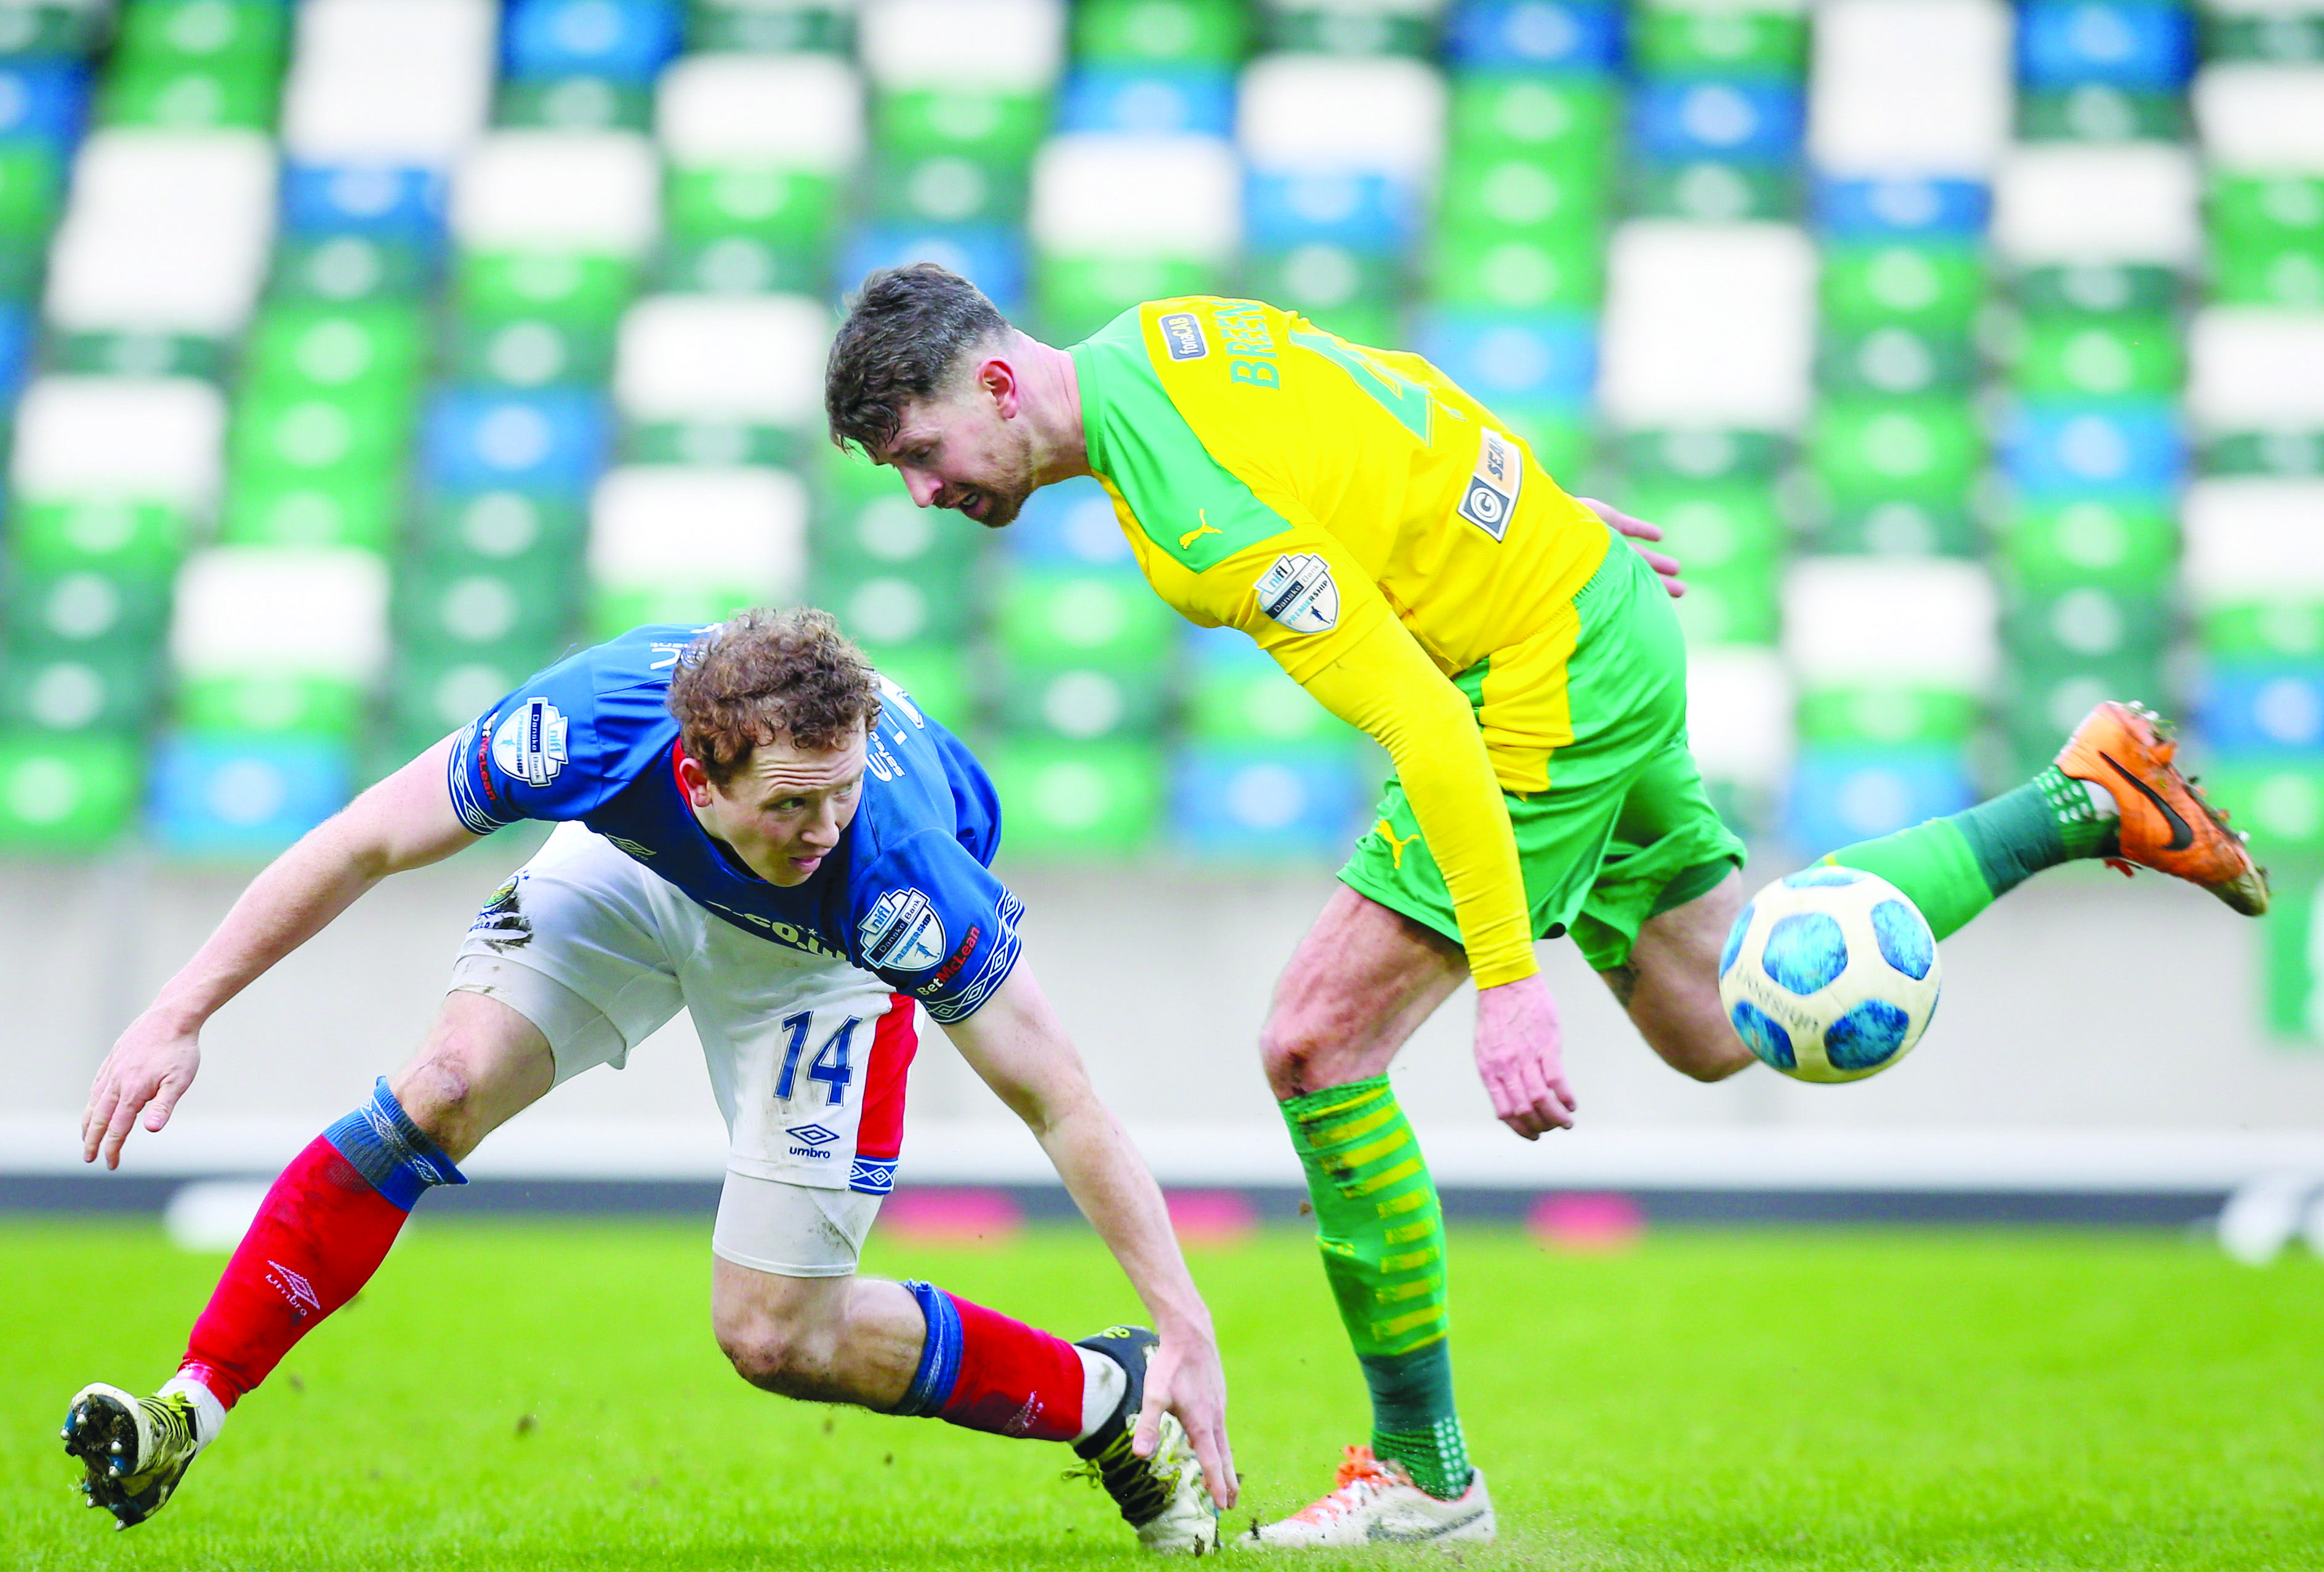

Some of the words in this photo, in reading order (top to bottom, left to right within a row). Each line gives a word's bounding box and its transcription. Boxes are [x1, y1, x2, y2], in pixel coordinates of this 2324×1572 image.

[1168, 316, 1200, 355] fonaCAB
[1211, 302, 1280, 390] BREEN
[1301, 565, 1319, 583] Bank
[1286, 579, 1328, 625] PREMIERSHIP
[532, 714, 540, 751] Danske
[533, 756, 541, 780] Bank
[872, 905, 891, 929] nifl
[879, 922, 906, 953] Danske
[904, 899, 921, 920] Bank
[892, 914, 931, 964] PREMIERSHIP
[917, 925, 981, 996] BetMcLean
[773, 1010, 862, 1106] 14
[789, 1147, 830, 1159] umbro
[265, 1273, 308, 1316] umbro
